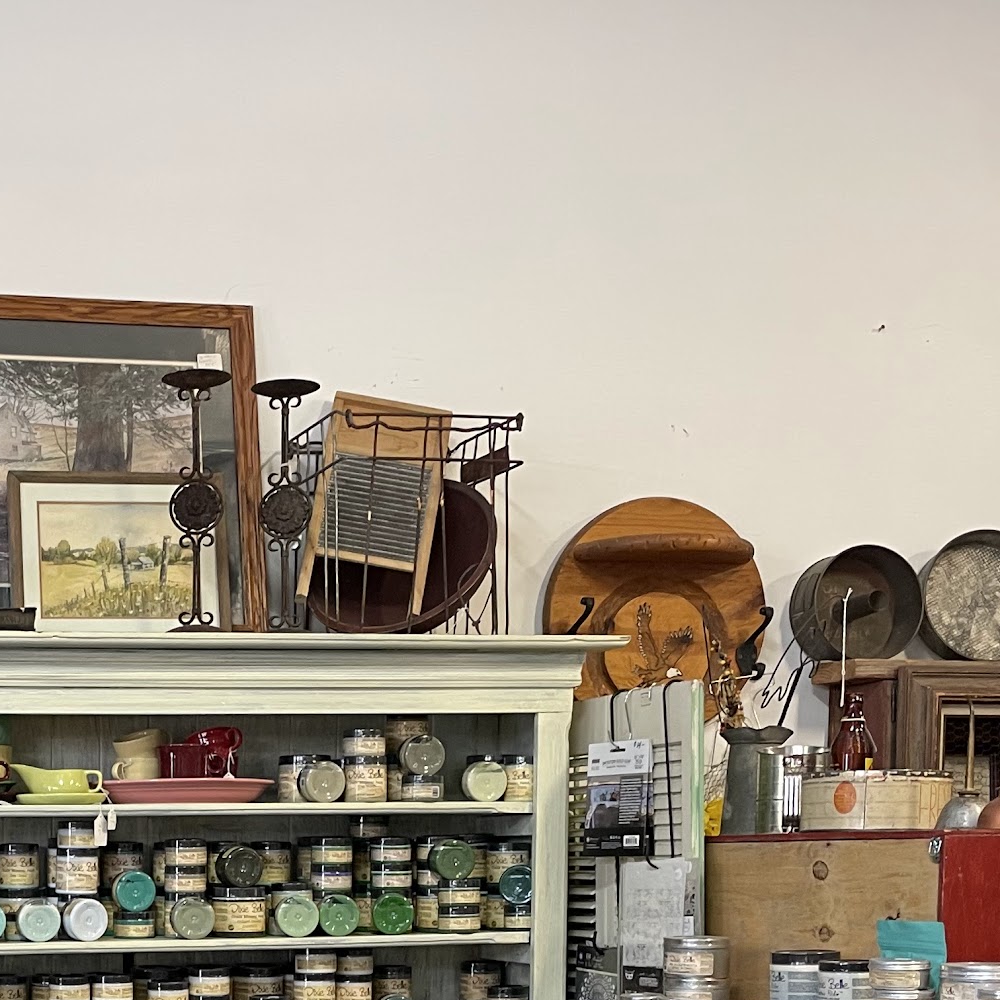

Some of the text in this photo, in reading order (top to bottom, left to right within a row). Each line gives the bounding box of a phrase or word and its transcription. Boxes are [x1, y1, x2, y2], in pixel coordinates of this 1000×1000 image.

[348, 769, 384, 779] Dixie Belle
[0, 857, 18, 867] Dixie
[65, 862, 84, 872] Dixie
[229, 903, 250, 914] Dixie
[828, 979, 849, 990] Belle
[307, 987, 326, 997] Dixie
[339, 988, 357, 997] Dixie
